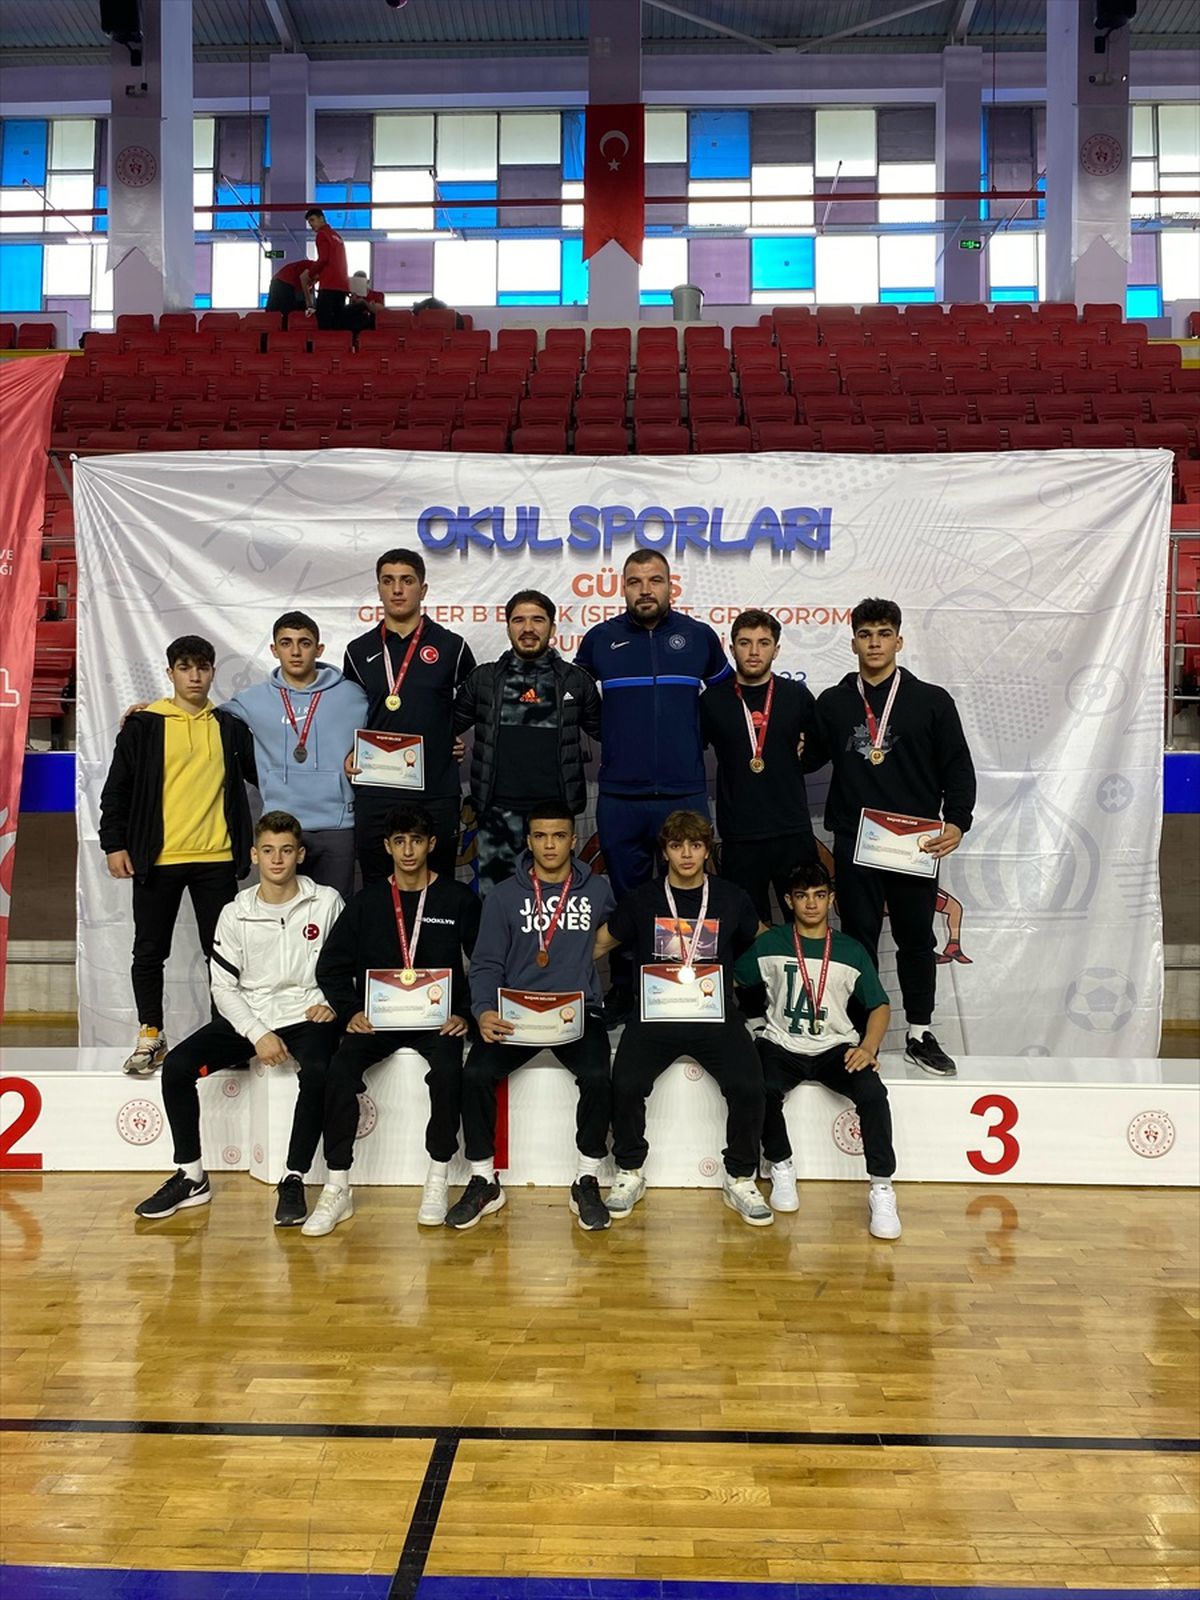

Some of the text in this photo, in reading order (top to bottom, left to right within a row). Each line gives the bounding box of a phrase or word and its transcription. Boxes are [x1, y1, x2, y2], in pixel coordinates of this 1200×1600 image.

[417, 504, 832, 553] OKUL SPORLARI
[571, 567, 682, 605] GÜŞ
[472, 605, 488, 623] B
[520, 913, 592, 933] JONES
[0, 1076, 43, 1169] 2
[966, 1094, 1021, 1176] 3
